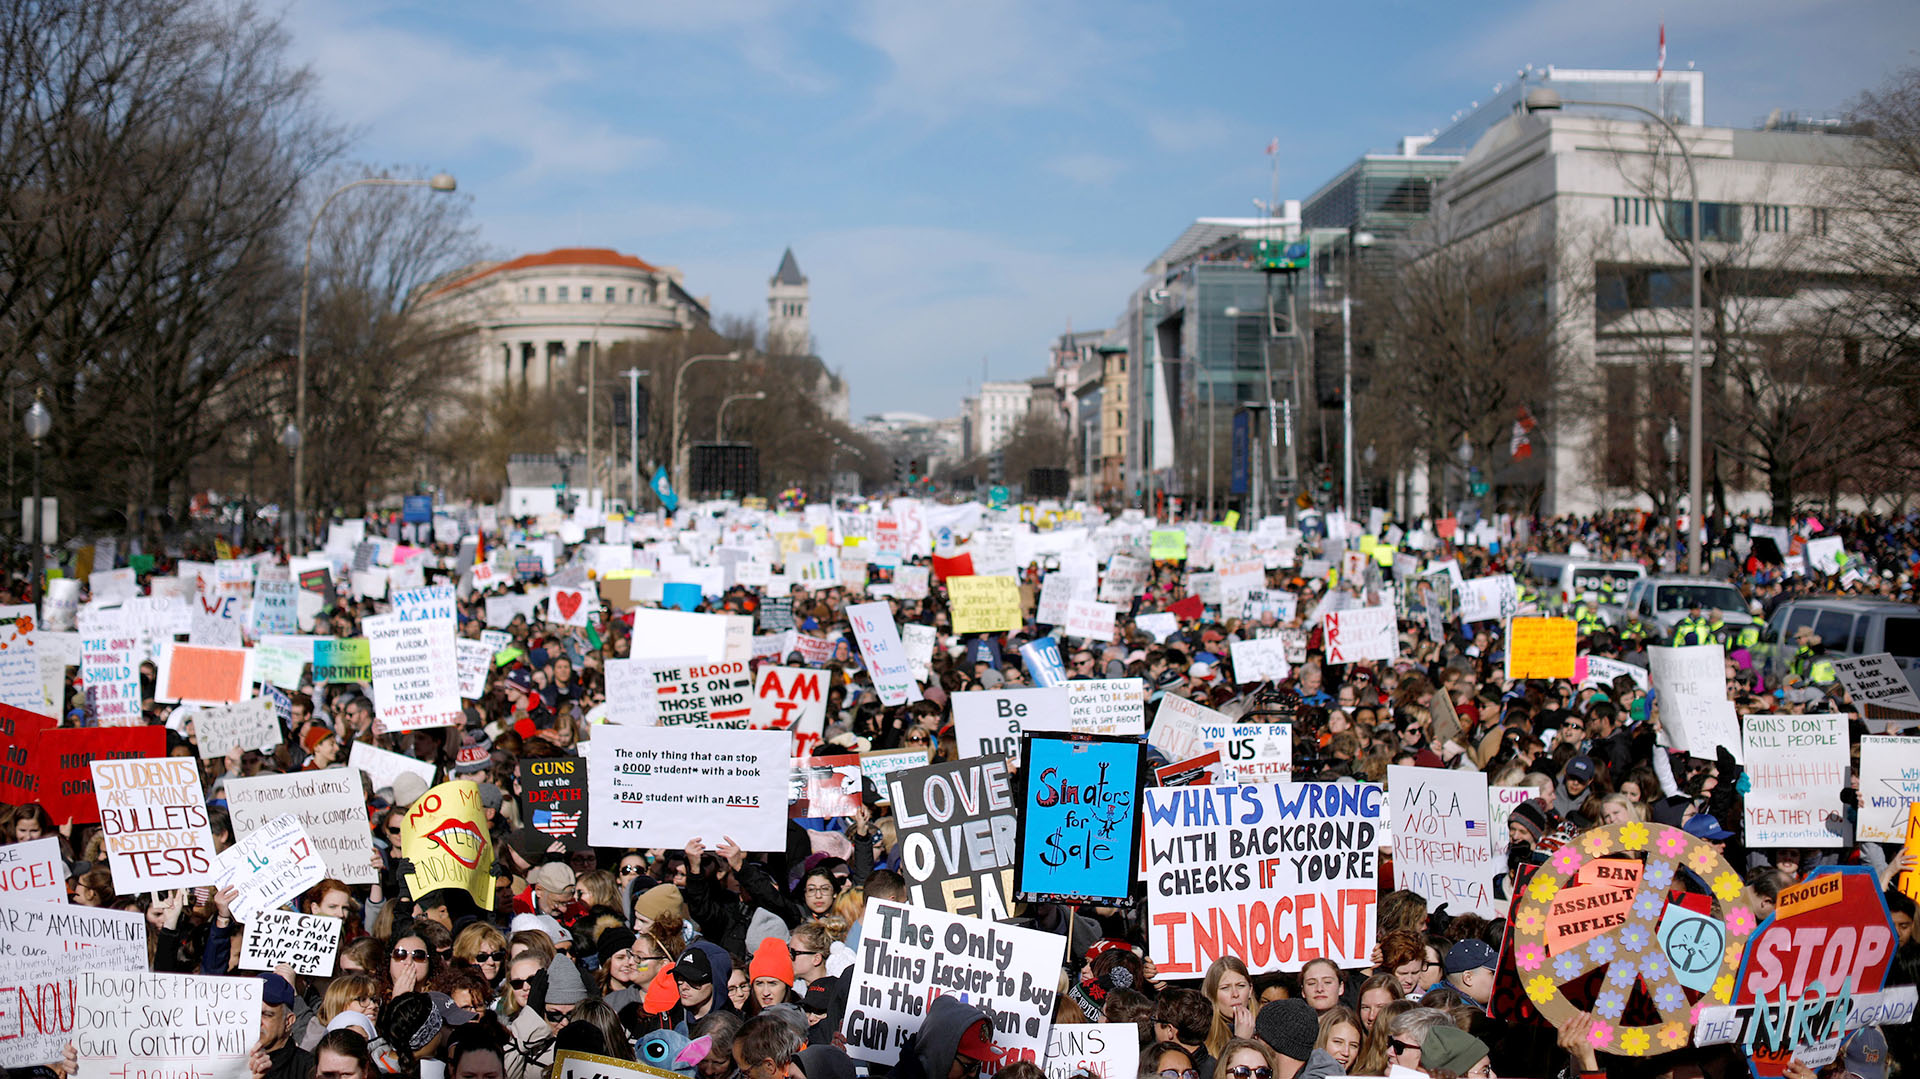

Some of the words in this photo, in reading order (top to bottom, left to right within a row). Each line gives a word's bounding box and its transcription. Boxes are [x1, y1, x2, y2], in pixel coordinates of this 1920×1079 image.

[202, 597, 236, 619] WE
[854, 615, 874, 633] No
[83, 640, 106, 650] THE
[110, 638, 136, 649] ONLY
[84, 654, 120, 664] THING
[85, 667, 130, 682] SHOULD
[314, 665, 371, 679] FORTNITE
[653, 669, 682, 683] THE
[689, 662, 743, 678] BLOOD
[122, 683, 137, 697] AT
[681, 683, 699, 694] IS
[708, 679, 730, 691] ON
[760, 671, 820, 701] AM
[86, 702, 126, 718] SCHOOL
[129, 701, 139, 713] IS
[659, 697, 706, 712] THOSE
[710, 693, 743, 707] WHO
[997, 698, 1028, 717] Be
[659, 711, 709, 727] REFUSE
[771, 702, 798, 727] I
[1792, 719, 1837, 732] DON'T
[1008, 719, 1021, 733] a
[1201, 727, 1225, 738] YOU
[1233, 726, 1262, 736] WORK
[1269, 725, 1288, 735] FOR
[1228, 739, 1255, 760] US
[1750, 736, 1781, 747] KILL
[615, 749, 633, 758] The
[636, 750, 657, 760] only
[661, 750, 687, 761] thing
[691, 751, 712, 761] that
[714, 754, 733, 762] can
[736, 753, 757, 763] stop
[862, 759, 888, 772] HAVE
[890, 757, 907, 767] YOU
[908, 755, 927, 765] EVER
[96, 761, 197, 790] STUDENTS
[531, 761, 575, 776] GUNS
[622, 763, 651, 773] GOOD
[701, 767, 725, 776] with
[736, 767, 760, 777] book
[539, 779, 553, 787] are
[556, 777, 570, 786] the
[106, 789, 134, 807] ARE
[138, 785, 197, 805] TAKING
[528, 788, 582, 803] DEATH
[550, 801, 560, 810] of
[621, 791, 643, 801] BAD
[645, 793, 684, 803] student
[686, 794, 709, 804] with
[726, 795, 760, 806] AR-15
[890, 760, 1012, 830] LOVE
[1146, 785, 1263, 827] WHAT'S
[1274, 783, 1382, 820] WRONG
[1403, 781, 1461, 818] NRA
[101, 805, 207, 835] BULLETS
[235, 810, 254, 832] So
[322, 806, 367, 825] congress
[410, 795, 441, 829] NO
[1065, 810, 1090, 829] for
[1746, 808, 1776, 825] YEA
[1778, 809, 1812, 824] THEY
[110, 833, 178, 853] INSTEAD
[181, 831, 201, 848] OF
[290, 837, 310, 864] 17
[903, 814, 1018, 882] OVER
[1151, 832, 1216, 865] WITH
[1230, 821, 1374, 858] BACKGROND
[118, 847, 210, 878] TESTS
[247, 850, 269, 873] 16
[1159, 863, 1250, 896] CHECKS
[1259, 858, 1280, 888] IF
[1291, 852, 1374, 883] YOU'RE
[1597, 866, 1638, 881] BAN
[1400, 872, 1489, 909] AMERICA
[1780, 878, 1840, 907] ENOUGH
[1553, 888, 1634, 916] ASSAULT
[25, 911, 43, 933] 2nd
[46, 914, 144, 941] AMENDMENT:
[256, 911, 290, 925] YOUR
[298, 915, 332, 933] GUN
[1153, 889, 1376, 973] INNOCENT
[1558, 913, 1626, 937] RIFLES
[253, 922, 272, 934] IS
[280, 925, 303, 938] NOT
[305, 932, 337, 945] MORE
[876, 904, 933, 950] The
[944, 922, 1013, 971] Only
[250, 935, 336, 955] IMPORTANT
[248, 948, 286, 959] THAN
[293, 953, 320, 965] OUR
[1748, 926, 1892, 996] STOP
[864, 938, 925, 984] Thing
[932, 952, 993, 994] Easier
[996, 969, 1014, 997] to
[1020, 972, 1053, 1016] Buy
[81, 972, 167, 1003] Thoughts
[184, 977, 253, 1008] Prayers
[78, 1005, 133, 1031] Don't
[139, 1005, 184, 1029] Save
[194, 1008, 248, 1028] Lives
[860, 981, 882, 1008] in
[888, 983, 922, 1016] the
[976, 998, 1020, 1034] than
[1025, 1017, 1041, 1038] a
[846, 1010, 889, 1051] Gun
[1704, 1021, 1735, 1041] THE
[1847, 1002, 1913, 1025] AGENDA
[78, 1032, 117, 1058] Gun
[129, 1029, 210, 1058] Control
[216, 1029, 246, 1056] Will
[1045, 1027, 1105, 1058] GUNS
